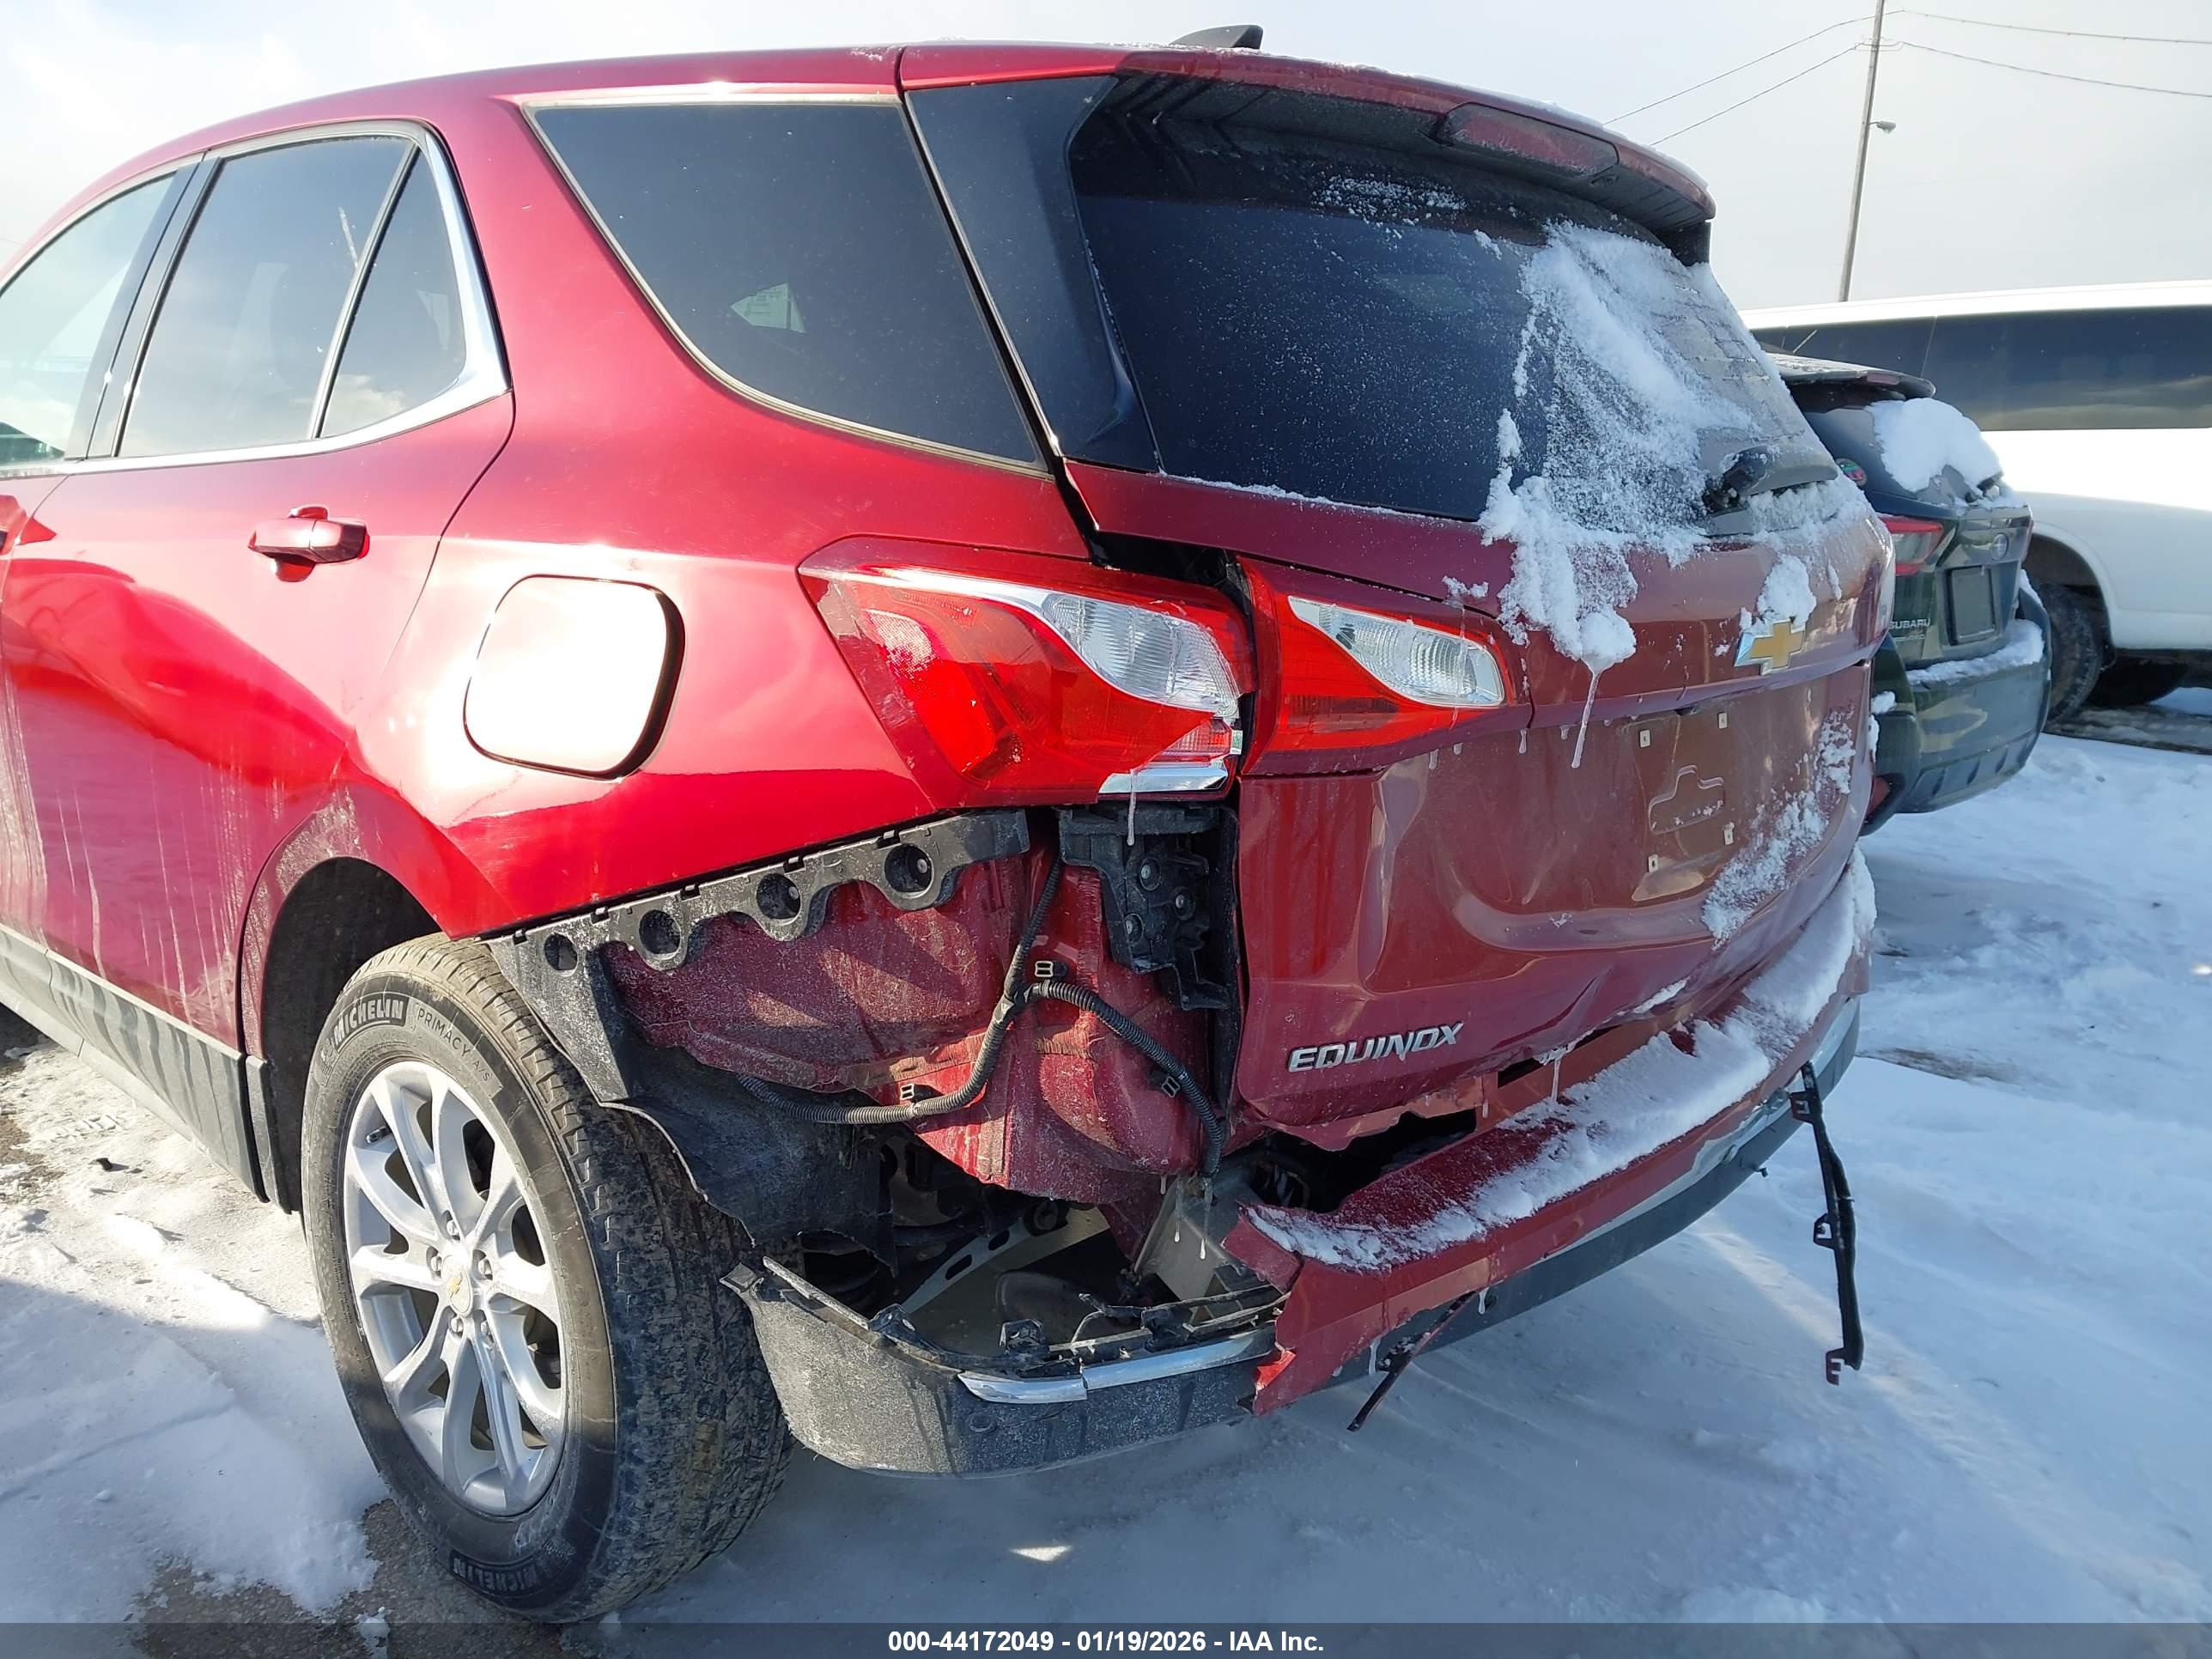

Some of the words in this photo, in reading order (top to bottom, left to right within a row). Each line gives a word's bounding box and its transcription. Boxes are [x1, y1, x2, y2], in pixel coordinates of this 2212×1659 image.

[1889, 618, 1931, 629] SUBARU
[332, 998, 404, 1048] MICHELIN
[417, 1007, 471, 1057] PRIMACY
[1288, 1022, 1464, 1073] EQUINOX
[453, 1557, 541, 1592] MICHELIN
